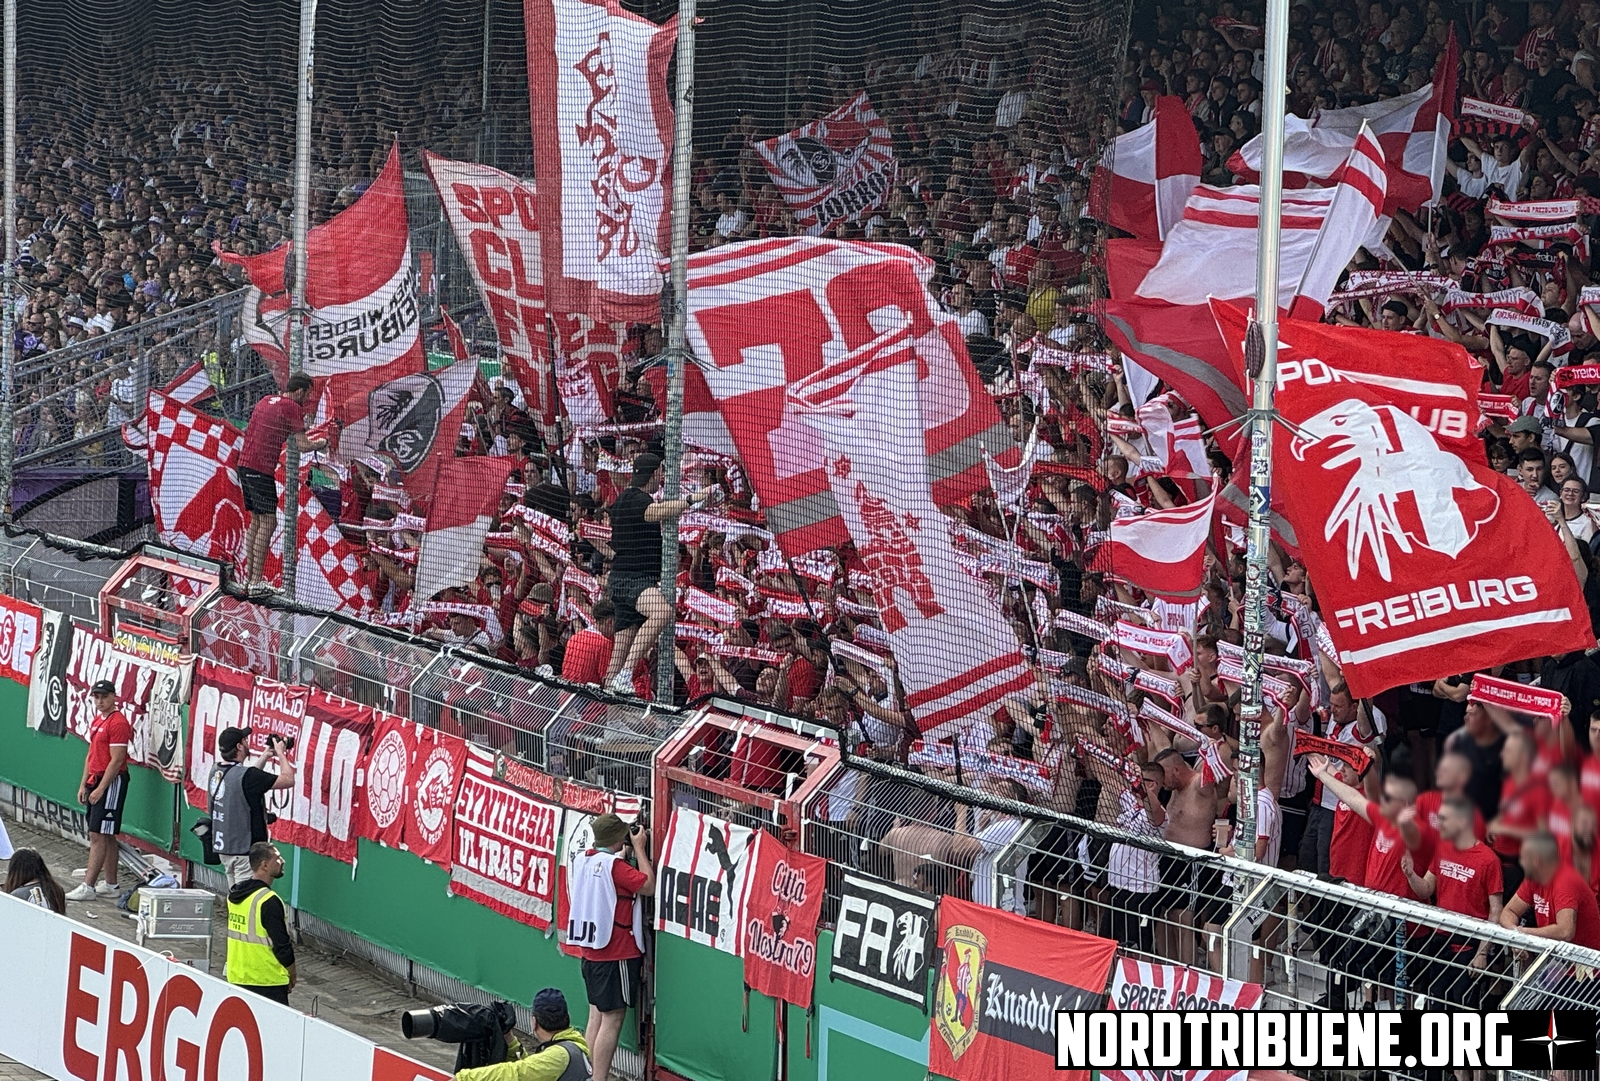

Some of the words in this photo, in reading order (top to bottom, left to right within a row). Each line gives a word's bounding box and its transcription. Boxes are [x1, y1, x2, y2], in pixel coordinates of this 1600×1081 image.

[253, 711, 271, 731] FÜR
[271, 718, 299, 740] IMMER
[255, 688, 304, 719] KHALID
[214, 831, 225, 851] 5
[456, 776, 555, 852] SYNTHESIA
[459, 827, 525, 887] ULTRAS
[527, 857, 550, 896] 19
[833, 894, 895, 975] FA
[62, 931, 265, 1081] ERGO
